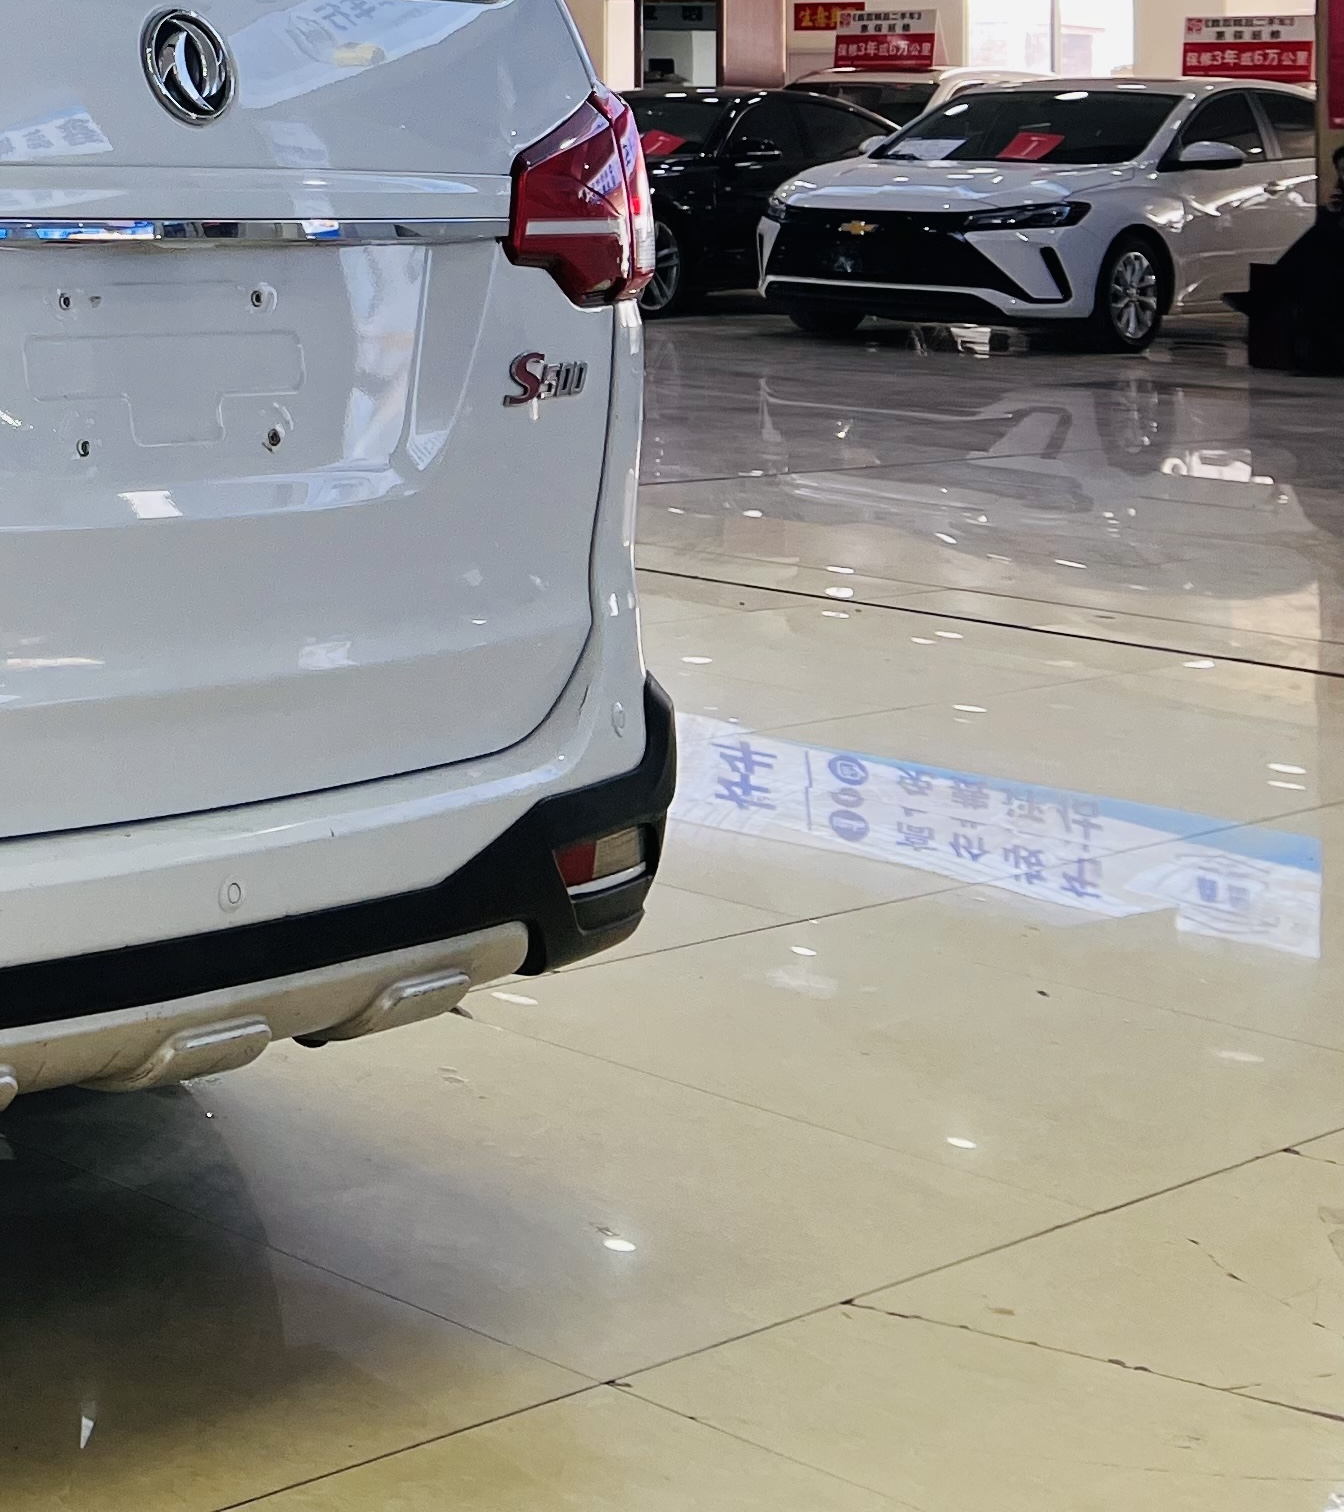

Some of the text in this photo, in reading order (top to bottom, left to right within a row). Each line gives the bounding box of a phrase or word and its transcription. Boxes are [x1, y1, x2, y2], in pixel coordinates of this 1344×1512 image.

[837, 40, 932, 58] 保修3年或6万公里
[1185, 49, 1310, 67] 保修3年或6万公里
